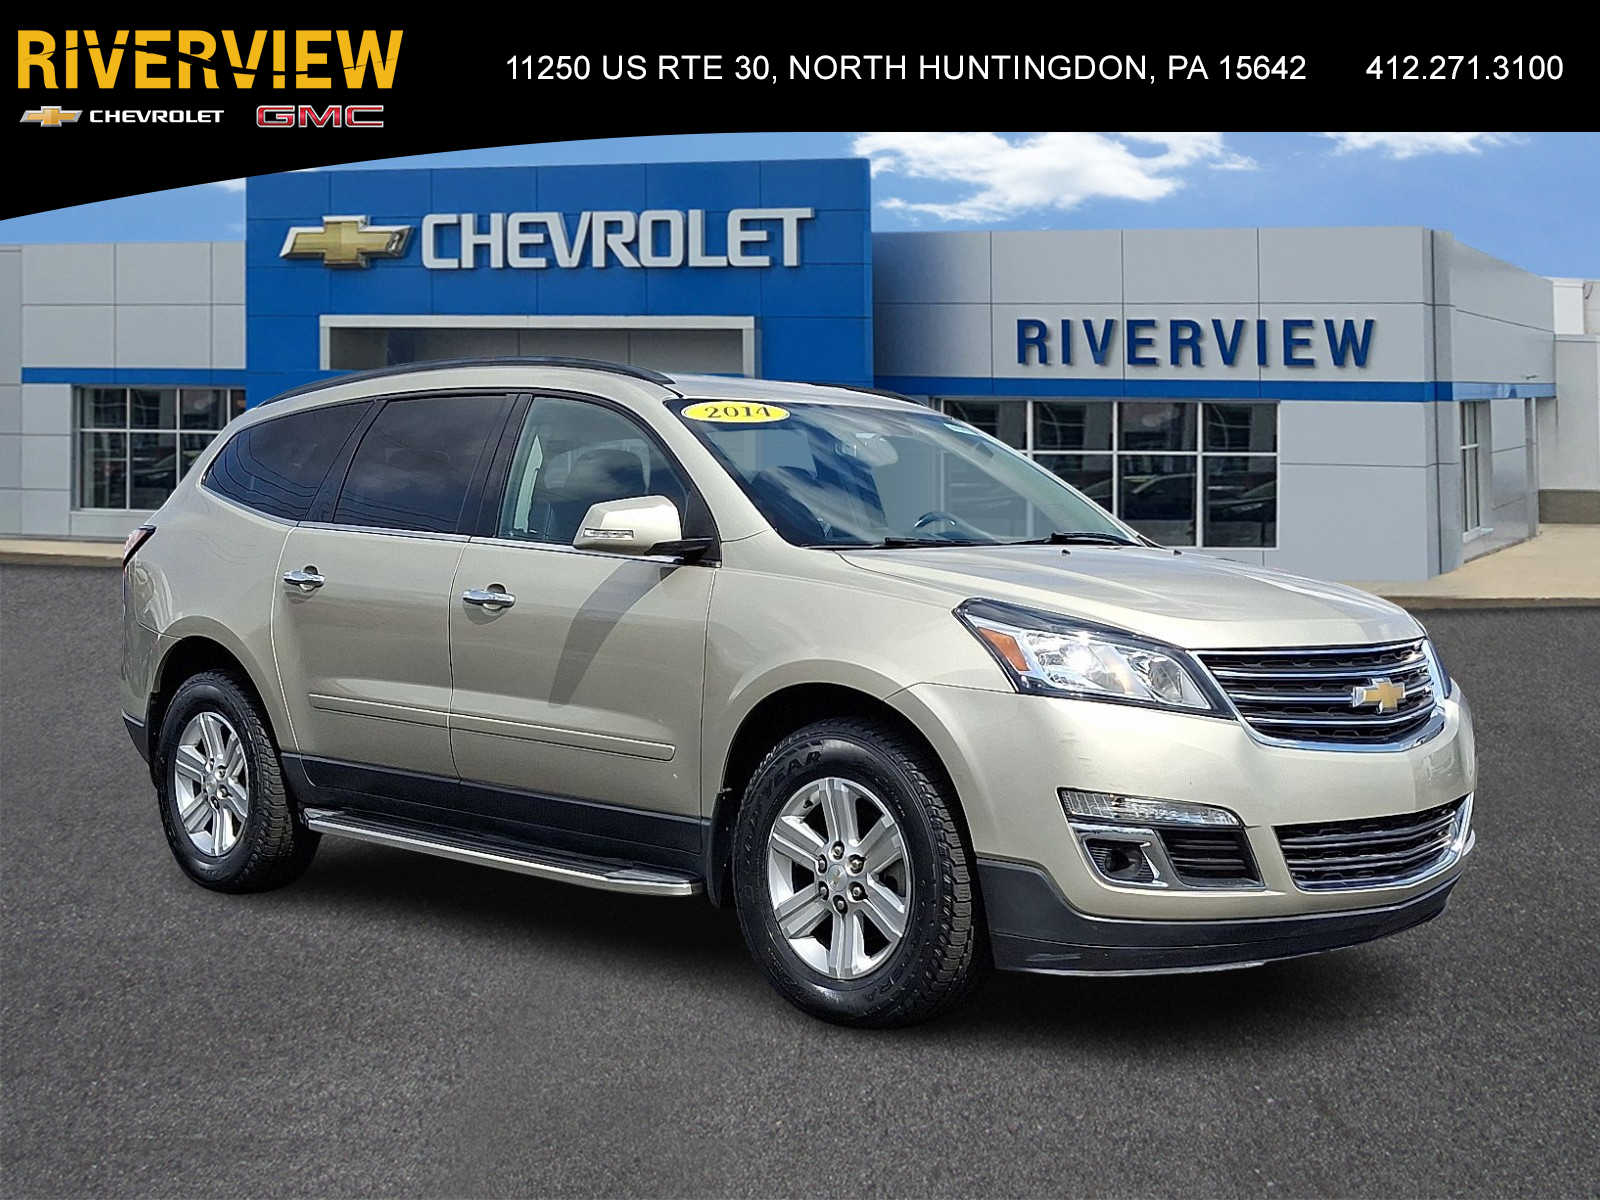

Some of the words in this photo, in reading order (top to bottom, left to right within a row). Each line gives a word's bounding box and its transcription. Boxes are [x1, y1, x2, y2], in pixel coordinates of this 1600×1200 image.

[421, 207, 815, 270] CHEVROLET
[1016, 318, 1376, 369] RIVERVIEW
[704, 405, 771, 419] 2014
